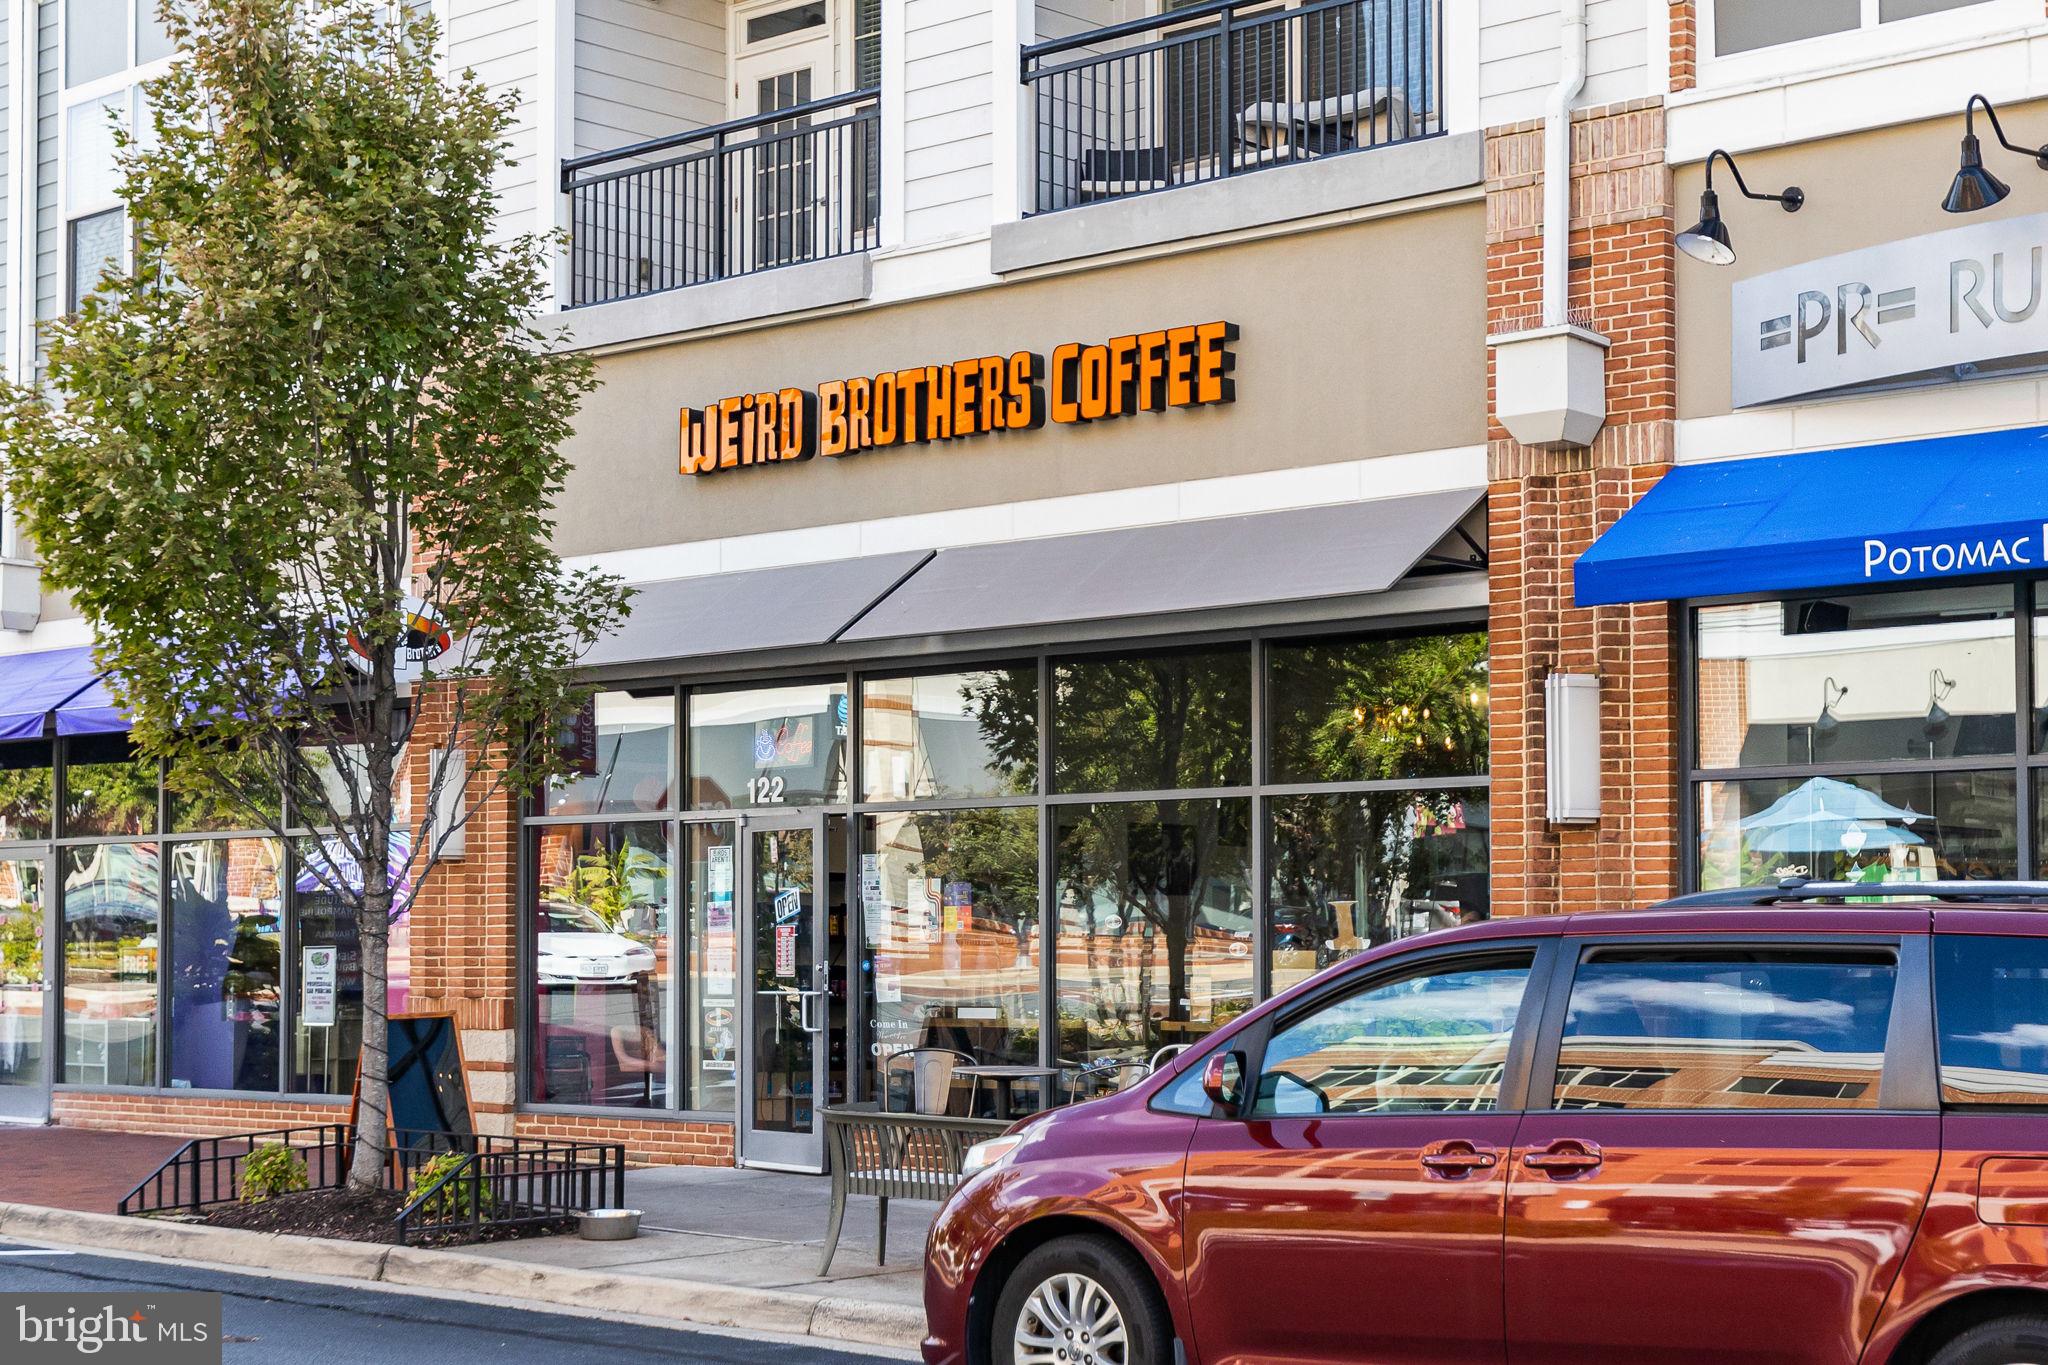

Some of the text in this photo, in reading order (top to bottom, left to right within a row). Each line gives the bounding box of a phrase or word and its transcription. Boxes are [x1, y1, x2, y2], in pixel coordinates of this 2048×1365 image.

[818, 350, 1034, 458] BROTHERS
[1051, 320, 1228, 424] COFFEE
[1863, 536, 2031, 577] POTOMAC
[775, 722, 813, 763] Coffee
[746, 776, 784, 804] 122
[776, 891, 799, 919] OPEN
[870, 1019, 909, 1029] Come In
[871, 1042, 915, 1058] OPEN
